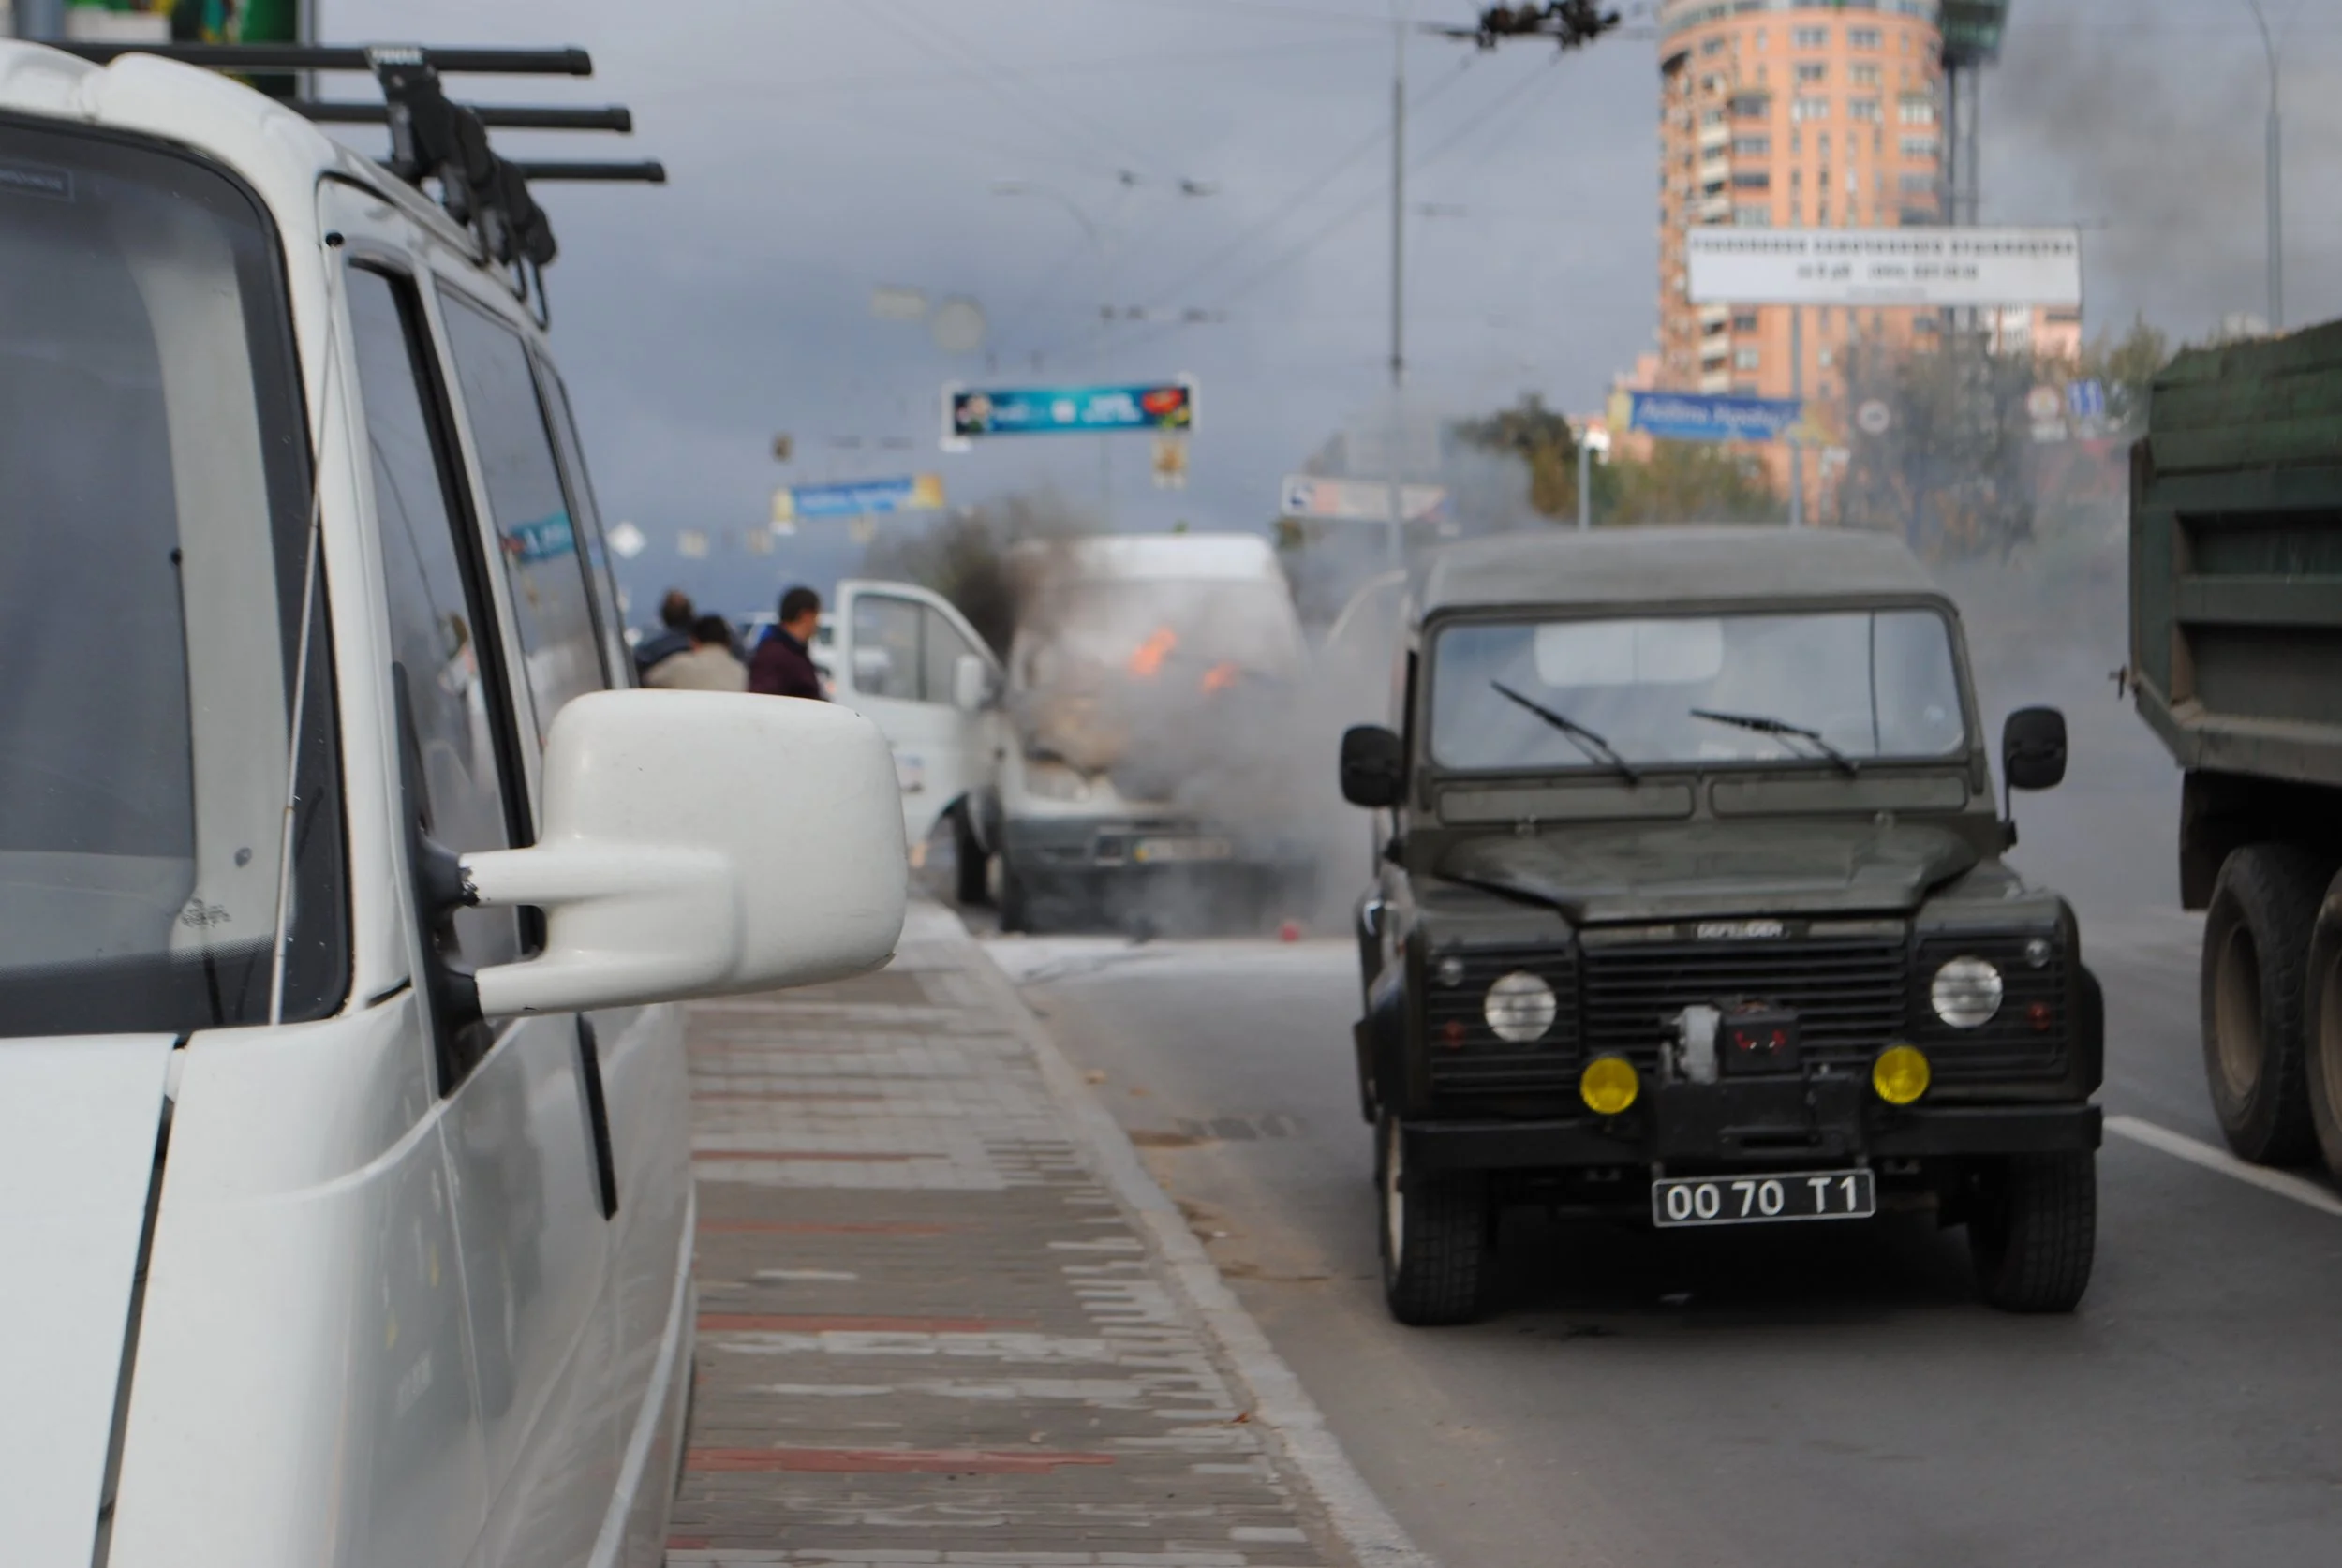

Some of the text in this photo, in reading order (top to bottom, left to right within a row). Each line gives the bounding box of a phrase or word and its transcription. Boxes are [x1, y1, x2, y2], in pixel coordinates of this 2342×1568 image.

[1667, 1176, 1857, 1220] 00 70 T1
